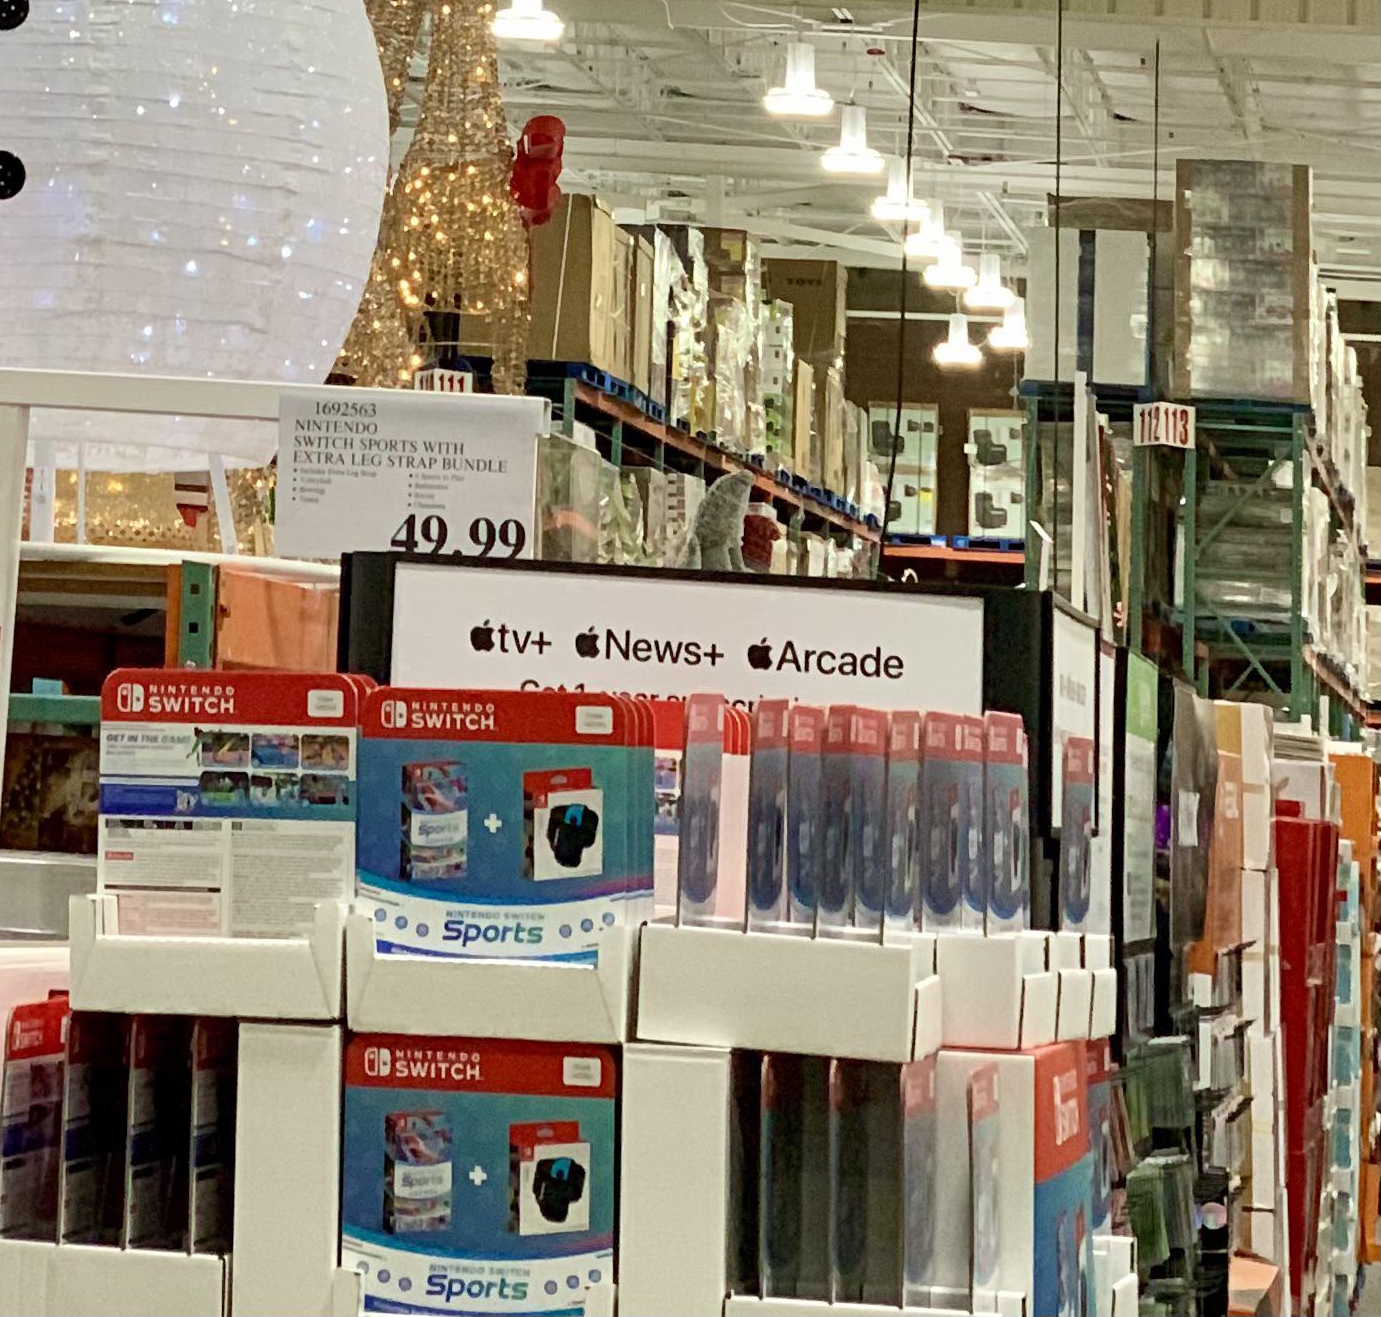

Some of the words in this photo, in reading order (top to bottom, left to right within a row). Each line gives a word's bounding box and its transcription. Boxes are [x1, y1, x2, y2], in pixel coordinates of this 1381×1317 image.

[314, 400, 378, 418] 1692563
[294, 419, 378, 435] NINTENDO
[1164, 407, 1189, 445] 113
[293, 435, 354, 451] SWITCH
[360, 438, 418, 453] SPORTS
[422, 440, 465, 455] WITH
[293, 451, 346, 465] EXTRA
[351, 453, 383, 467] LEG
[387, 455, 438, 470] STRAP
[442, 458, 509, 473] BUNDLE
[390, 513, 526, 559] 49.99
[498, 623, 552, 655] tv+
[605, 629, 725, 666] News+
[776, 640, 905, 679] Arcade
[149, 684, 235, 696] NINTENDO
[149, 696, 236, 714] SWITCH
[411, 701, 495, 714] NINTENDO
[411, 714, 496, 730] SWITCH
[442, 919, 544, 946] Sports
[395, 1050, 480, 1063] NINTENDO
[395, 1061, 481, 1080] SWITCH
[425, 1274, 529, 1302] Sports
